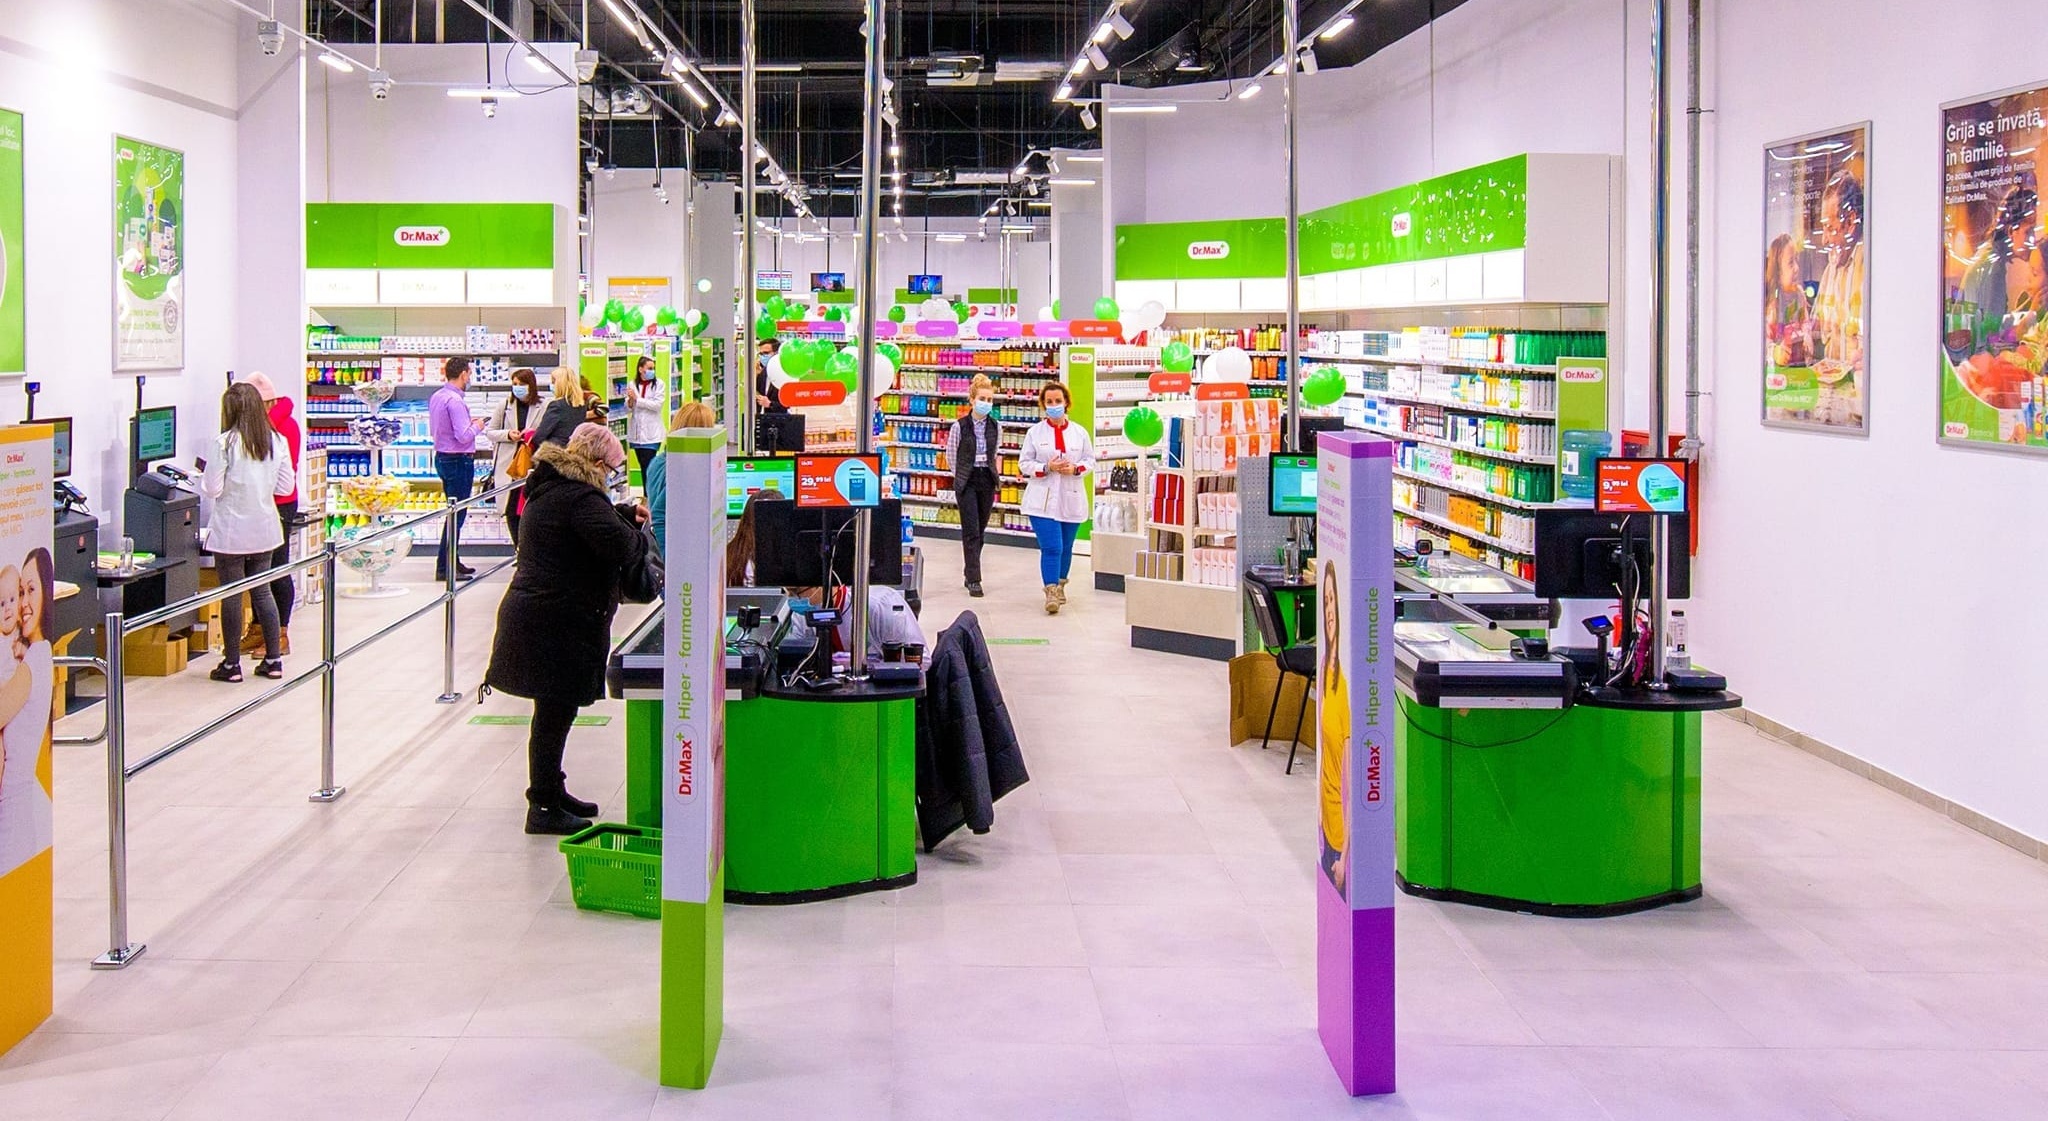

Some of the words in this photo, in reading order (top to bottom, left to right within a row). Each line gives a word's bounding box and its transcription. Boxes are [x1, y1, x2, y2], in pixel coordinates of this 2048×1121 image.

[1946, 121, 1975, 143] Grija
[1978, 121, 1994, 136] se
[1997, 107, 2041, 133] învață
[1945, 149, 1957, 166] în
[1960, 140, 2008, 164] familie.
[2004, 164, 2012, 172] de
[1979, 180, 1987, 188] de
[1988, 178, 2012, 188] produse
[2013, 175, 2022, 183] de
[400, 231, 440, 241] Dr.Max
[1192, 245, 1222, 255] Dr.Max
[1565, 371, 1596, 379] Dr.Max
[678, 581, 693, 659] farmacie
[1365, 587, 1379, 665] farmacie
[678, 673, 694, 720] Hiper
[1366, 678, 1382, 727] Hiper
[678, 739, 692, 796] Dr.Max
[1367, 745, 1381, 803] Dr.Max
